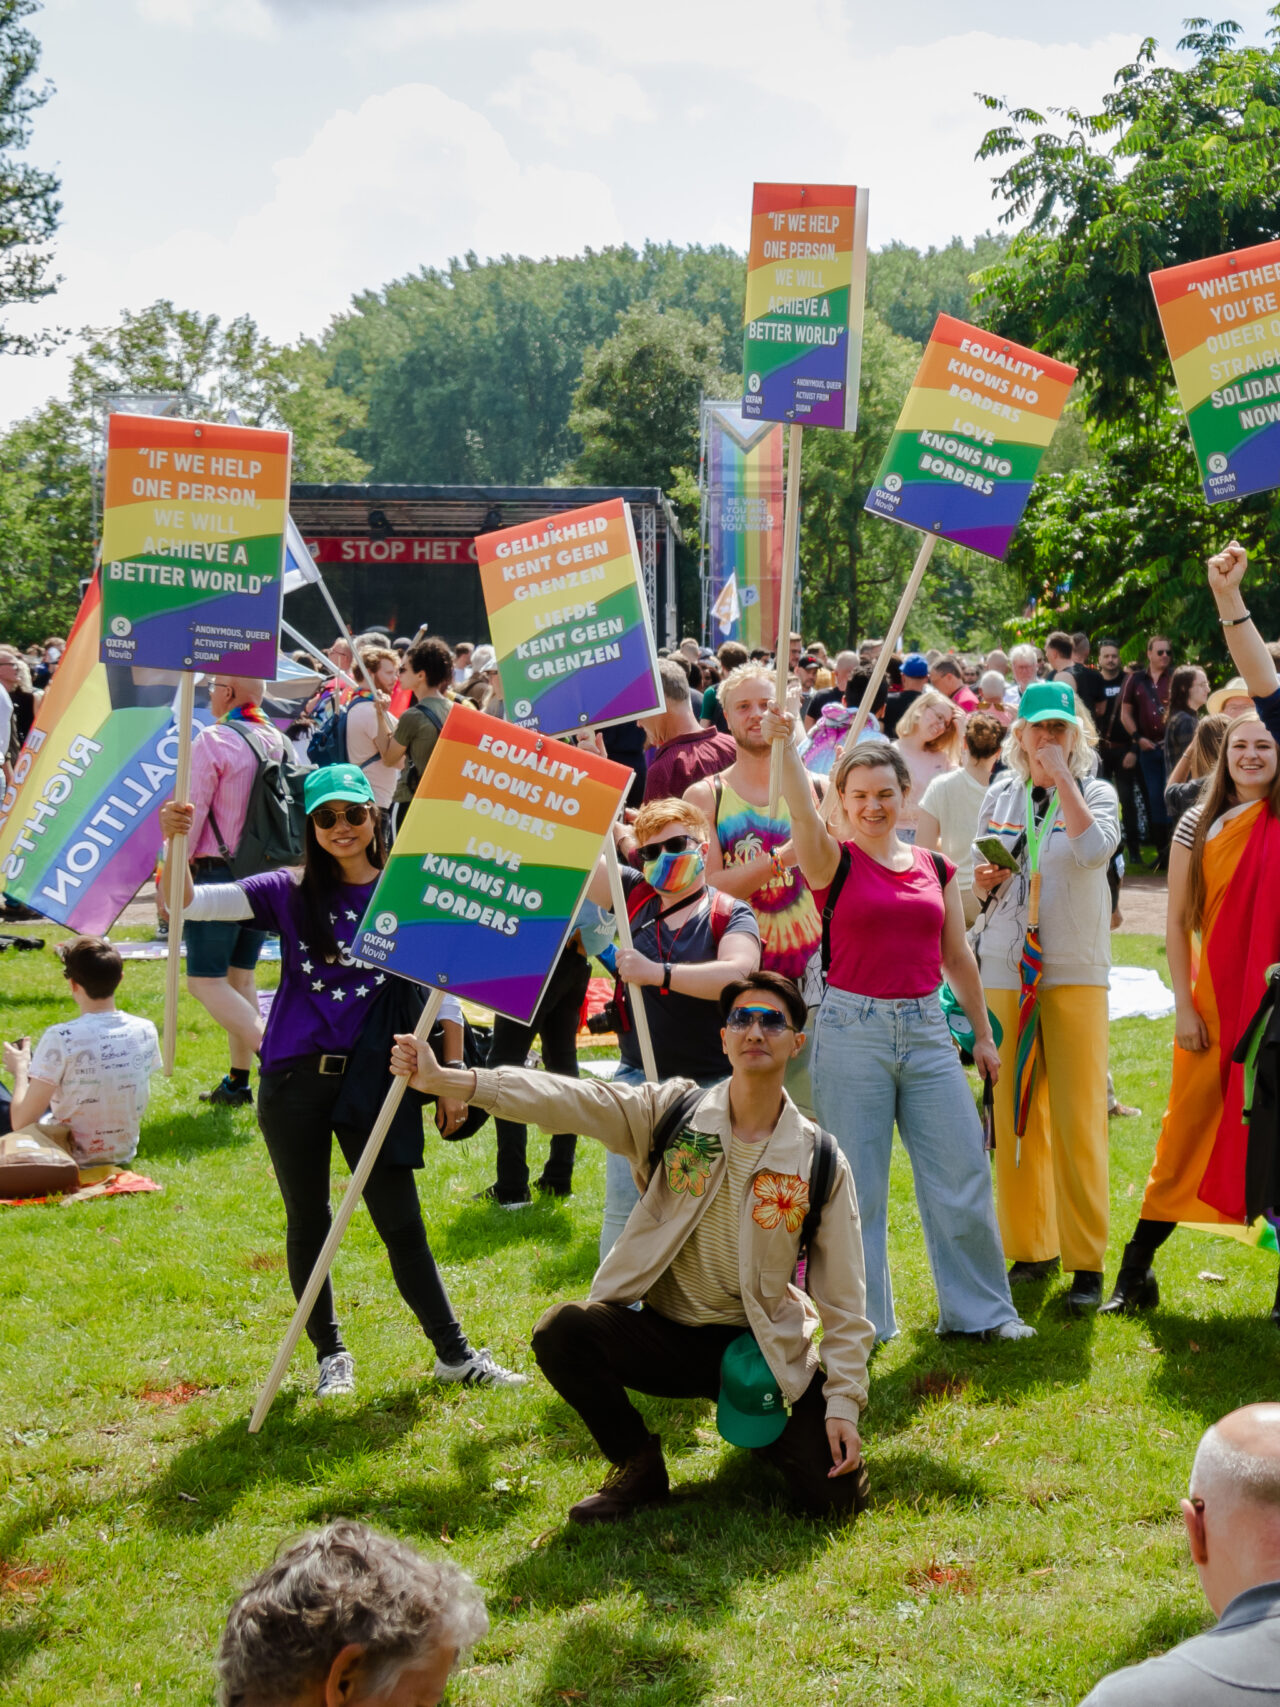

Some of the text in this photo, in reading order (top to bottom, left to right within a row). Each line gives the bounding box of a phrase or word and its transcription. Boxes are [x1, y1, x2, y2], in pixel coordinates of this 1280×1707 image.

[768, 212, 839, 233] “IF WE HELP
[764, 241, 839, 263] ONE PERSON,
[775, 269, 825, 289] WE WILL
[768, 296, 829, 317] ACHIEVE A
[749, 321, 844, 345] BETTER WORLD”
[1206, 323, 1267, 354] QUEER
[960, 338, 1044, 381] EQUALITY
[947, 359, 1038, 404] KNOWS NO
[949, 384, 1020, 423] BORDERS
[953, 418, 995, 446] LOVE
[138, 448, 262, 479] “IF WE HELP
[919, 430, 1012, 476] KNOWS NO
[920, 455, 994, 494] BORDERS
[1209, 473, 1236, 486] OXFAM
[133, 477, 262, 510] ONE PERSON,
[875, 489, 901, 505] OXFAM
[1214, 484, 1235, 496] Novib
[874, 499, 894, 512] Novib
[154, 508, 239, 535] WE WILL
[143, 536, 248, 565] ACHIEVE A
[341, 541, 405, 560] STOP
[413, 541, 461, 560] HET
[495, 518, 608, 558] GELIJKHEID
[502, 541, 609, 582] KENT GEEN
[110, 561, 272, 594] BETTER WORLD”
[514, 566, 606, 601] GRENZEN
[534, 601, 598, 630] LIEFDE
[106, 639, 135, 650] OXFAM
[195, 625, 270, 640] ANONYMOUS, QUEER
[195, 639, 250, 651] ACTIVIST FROM
[517, 618, 624, 660] KENT GEEN
[108, 649, 132, 660] Novib
[194, 652, 219, 661] SUDAN
[527, 643, 621, 680] GRENZEN
[478, 734, 589, 786] EQUALITY
[461, 759, 580, 816] KNOWS NO
[462, 793, 555, 841] BORDERS
[466, 837, 522, 872] LOVE
[423, 853, 542, 910] KNOWS NO
[423, 885, 519, 936] BORDERS
[361, 945, 386, 961] Novib
[364, 933, 395, 951] OXFAM
